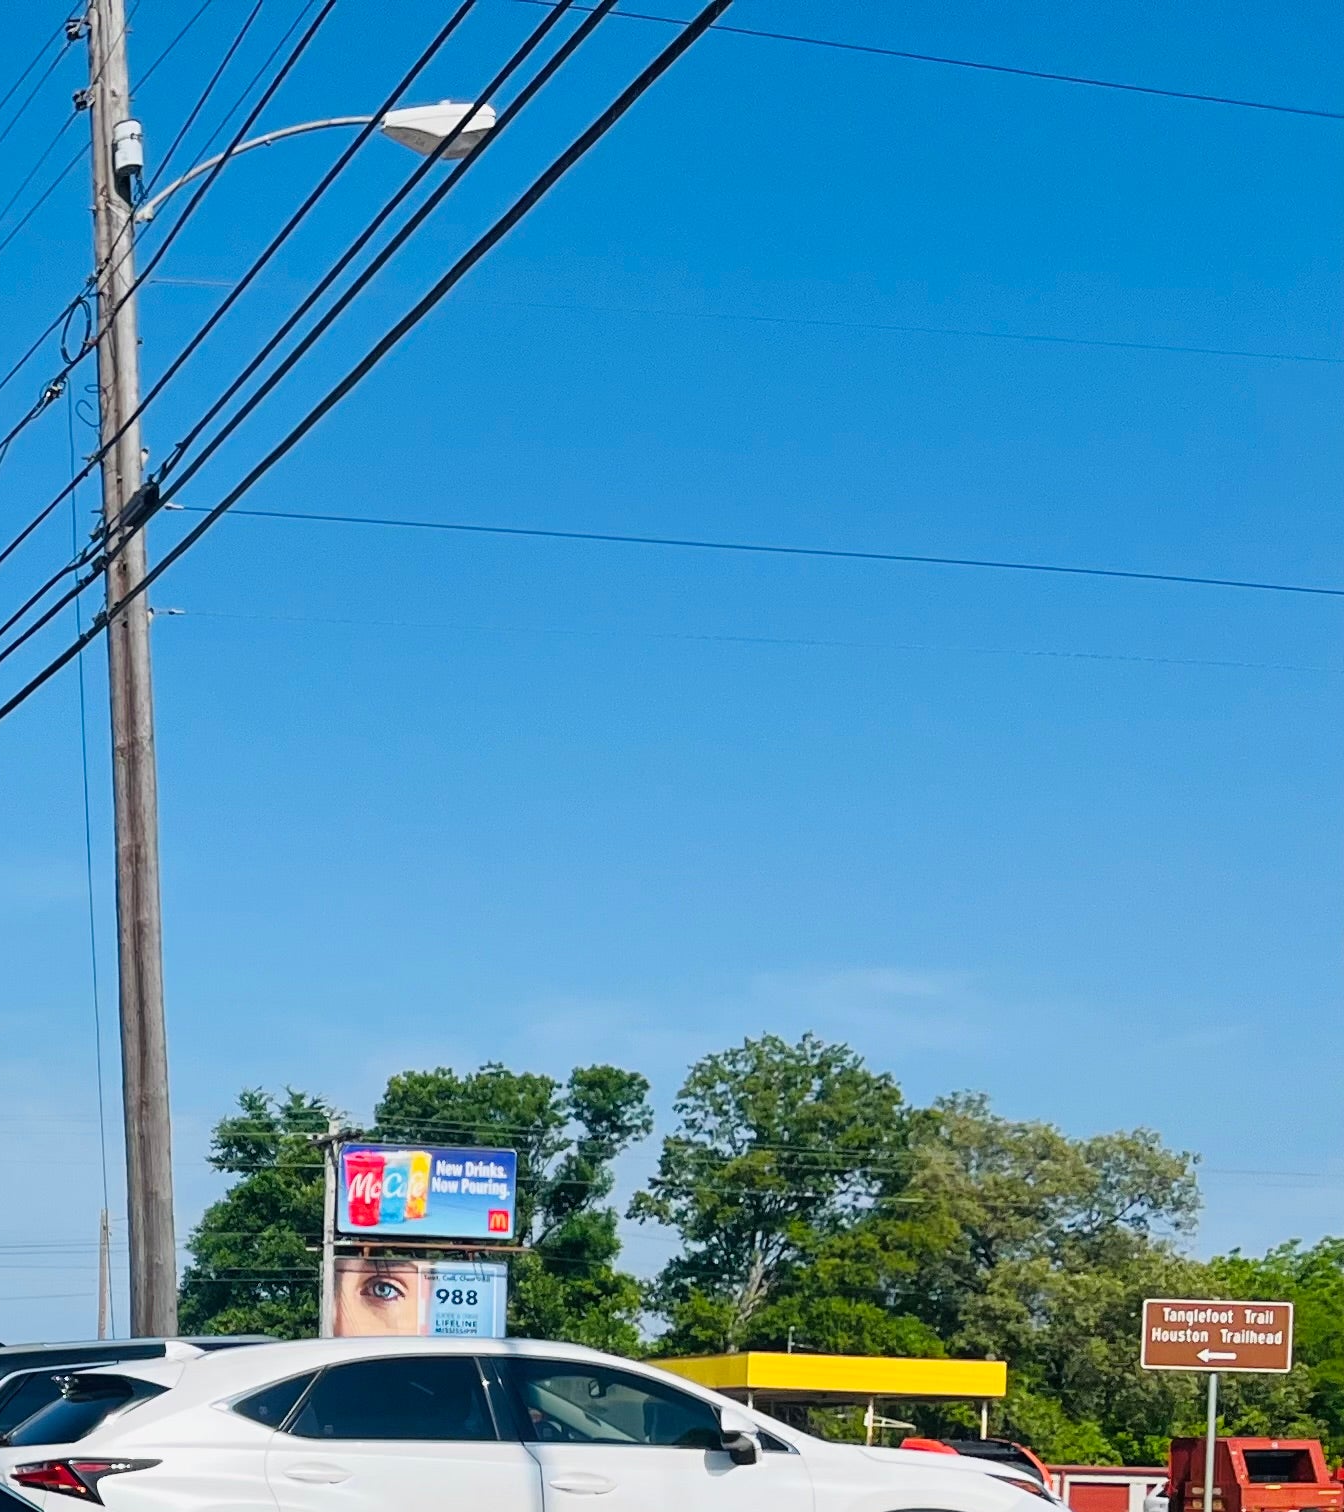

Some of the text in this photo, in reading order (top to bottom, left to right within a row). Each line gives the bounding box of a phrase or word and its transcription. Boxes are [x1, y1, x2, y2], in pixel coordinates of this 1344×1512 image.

[436, 1160, 507, 1179] New Drinks.
[432, 1177, 510, 1201] Now Pouring.
[435, 1288, 478, 1306] 988
[435, 1319, 478, 1328] LIFELINE
[1162, 1307, 1274, 1327] Tanglefoot Trail
[1152, 1327, 1283, 1345] Houston Trailhead
